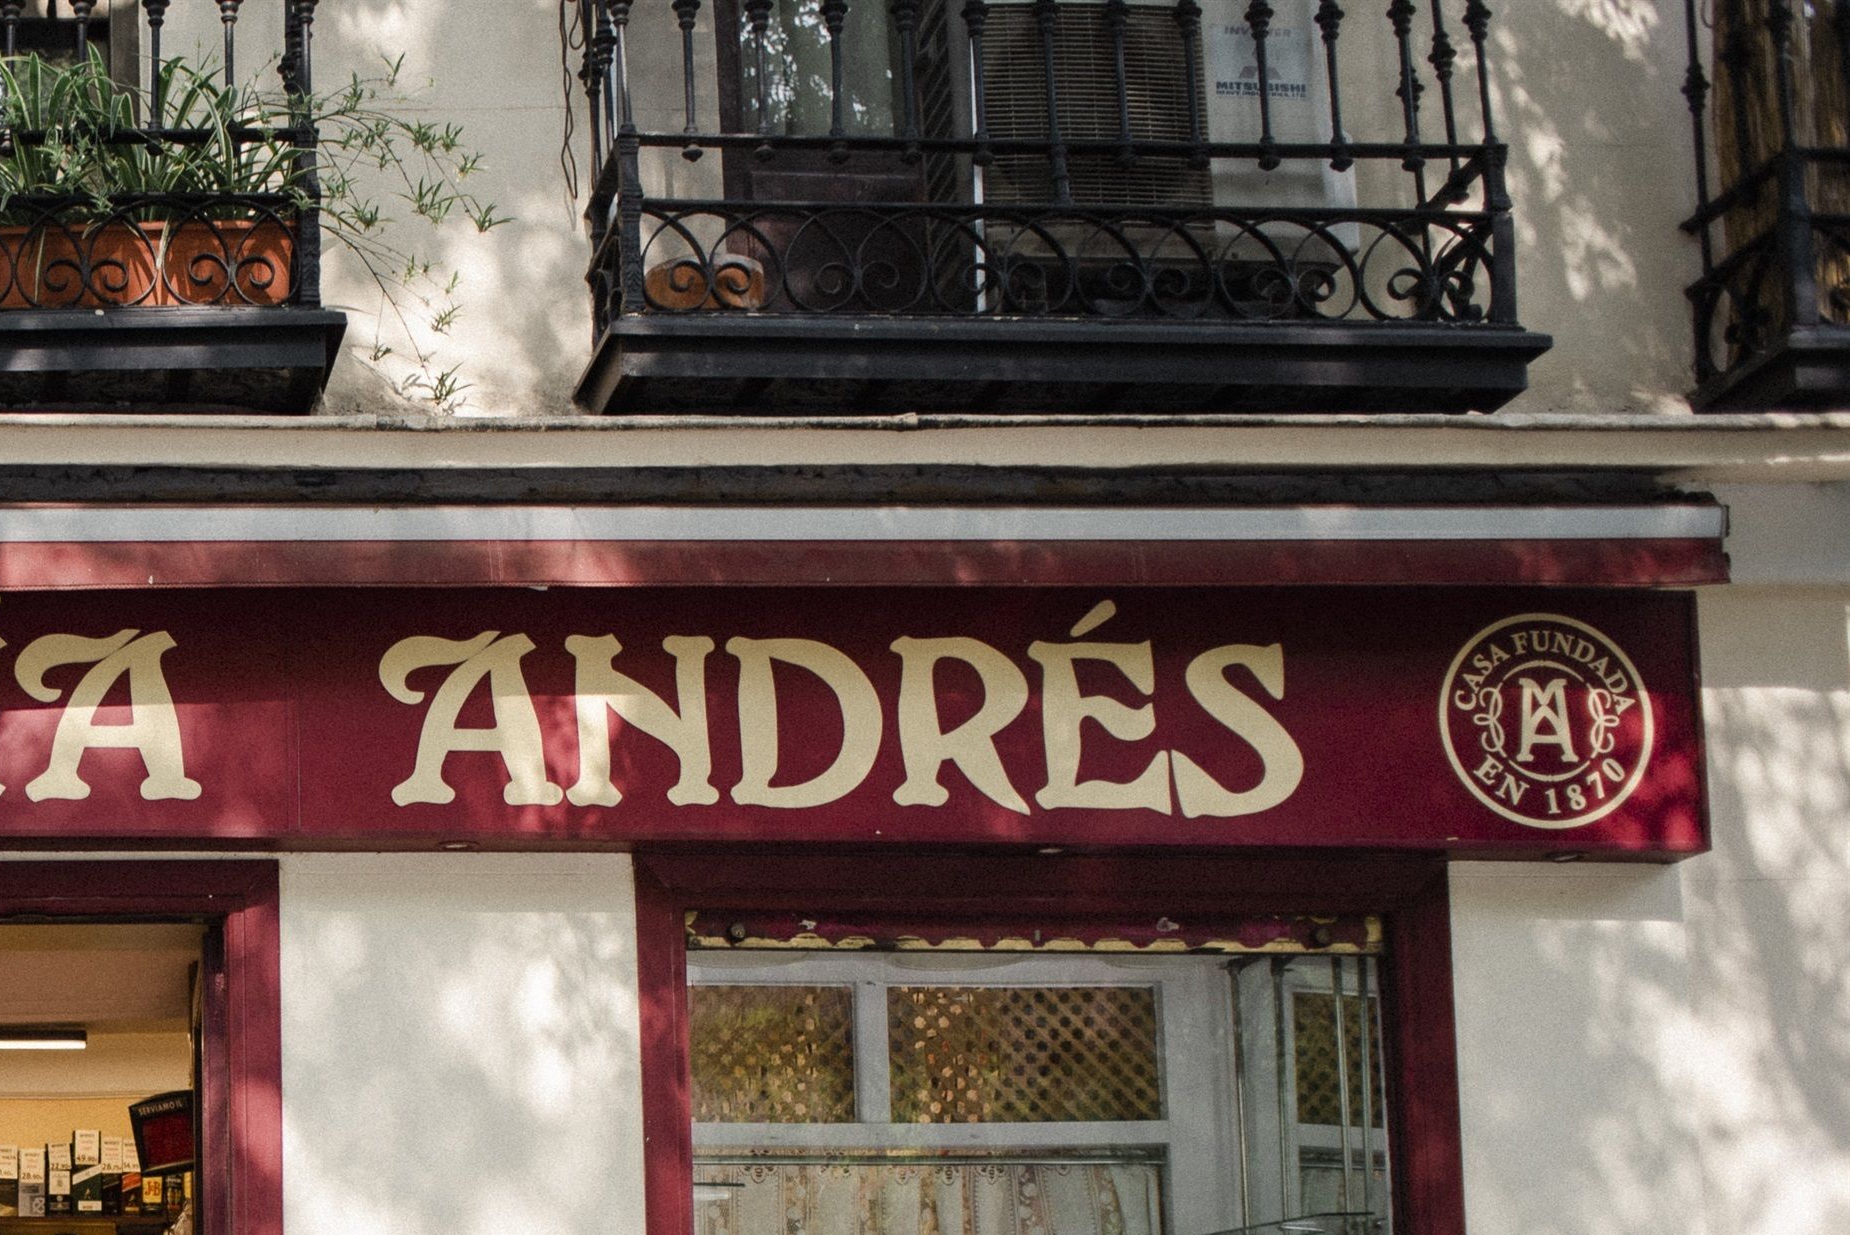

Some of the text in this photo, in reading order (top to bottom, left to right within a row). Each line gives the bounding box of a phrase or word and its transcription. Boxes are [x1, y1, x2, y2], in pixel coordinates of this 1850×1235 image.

[379, 600, 1304, 819] ANDRÉS
[1455, 630, 1636, 716] CASA FUNDADA
[1473, 755, 1626, 814] EN 1870
